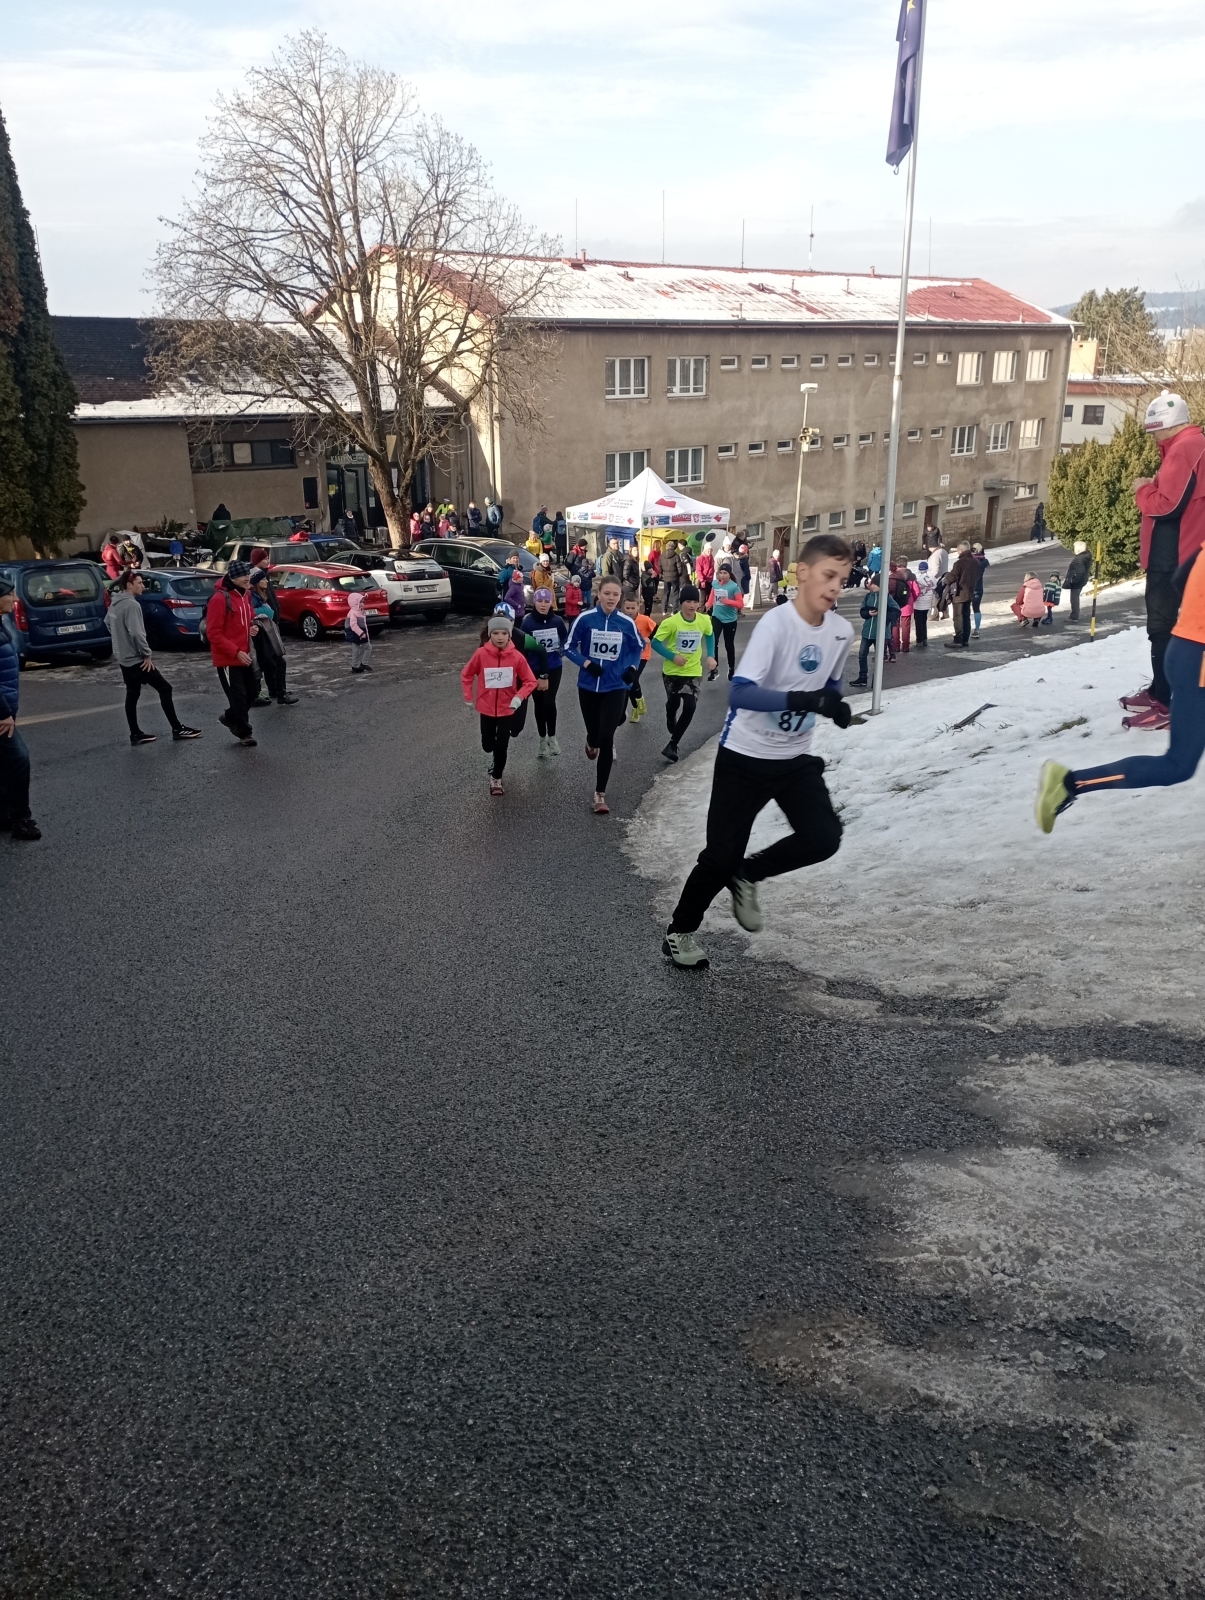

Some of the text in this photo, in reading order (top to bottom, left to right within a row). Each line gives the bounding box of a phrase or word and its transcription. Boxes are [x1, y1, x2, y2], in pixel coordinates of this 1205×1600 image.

[593, 642, 618, 655] 104
[682, 640, 695, 648] 97
[487, 671, 502, 681] 58
[779, 710, 807, 732] 87
